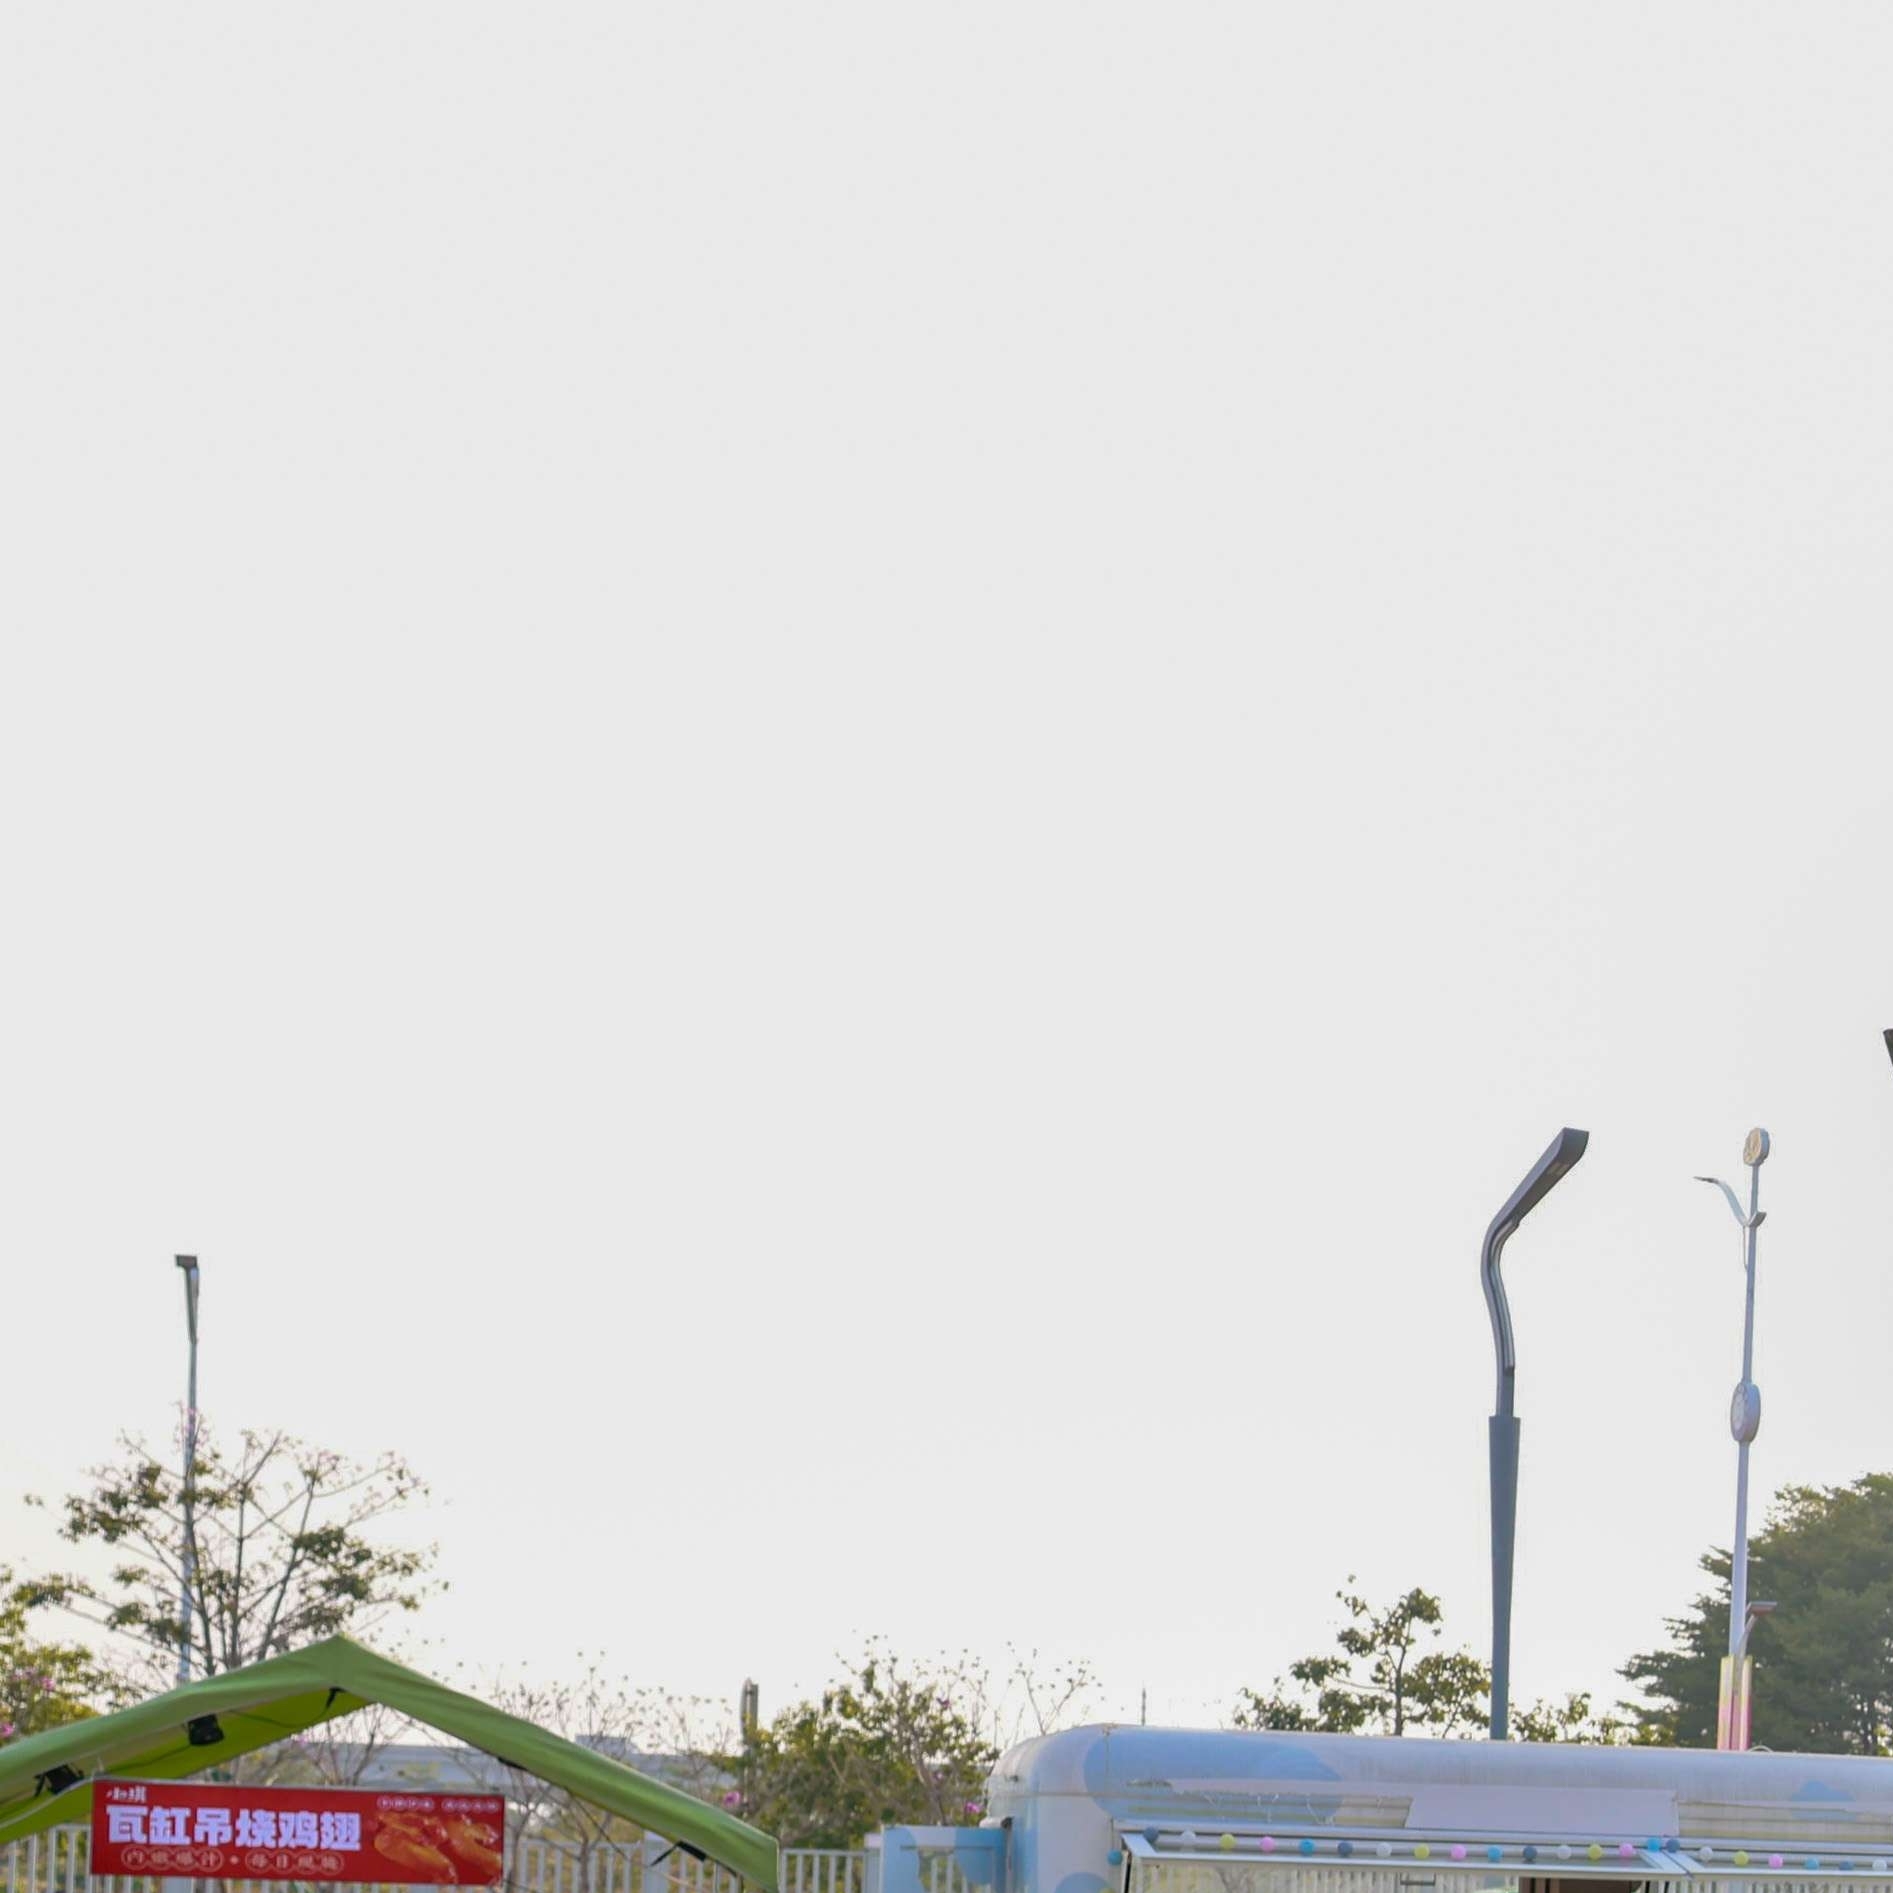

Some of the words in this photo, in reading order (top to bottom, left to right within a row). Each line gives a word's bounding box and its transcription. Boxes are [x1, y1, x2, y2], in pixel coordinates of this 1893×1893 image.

[105, 1805, 362, 1852] 瓦缸吊烧鸡翅
